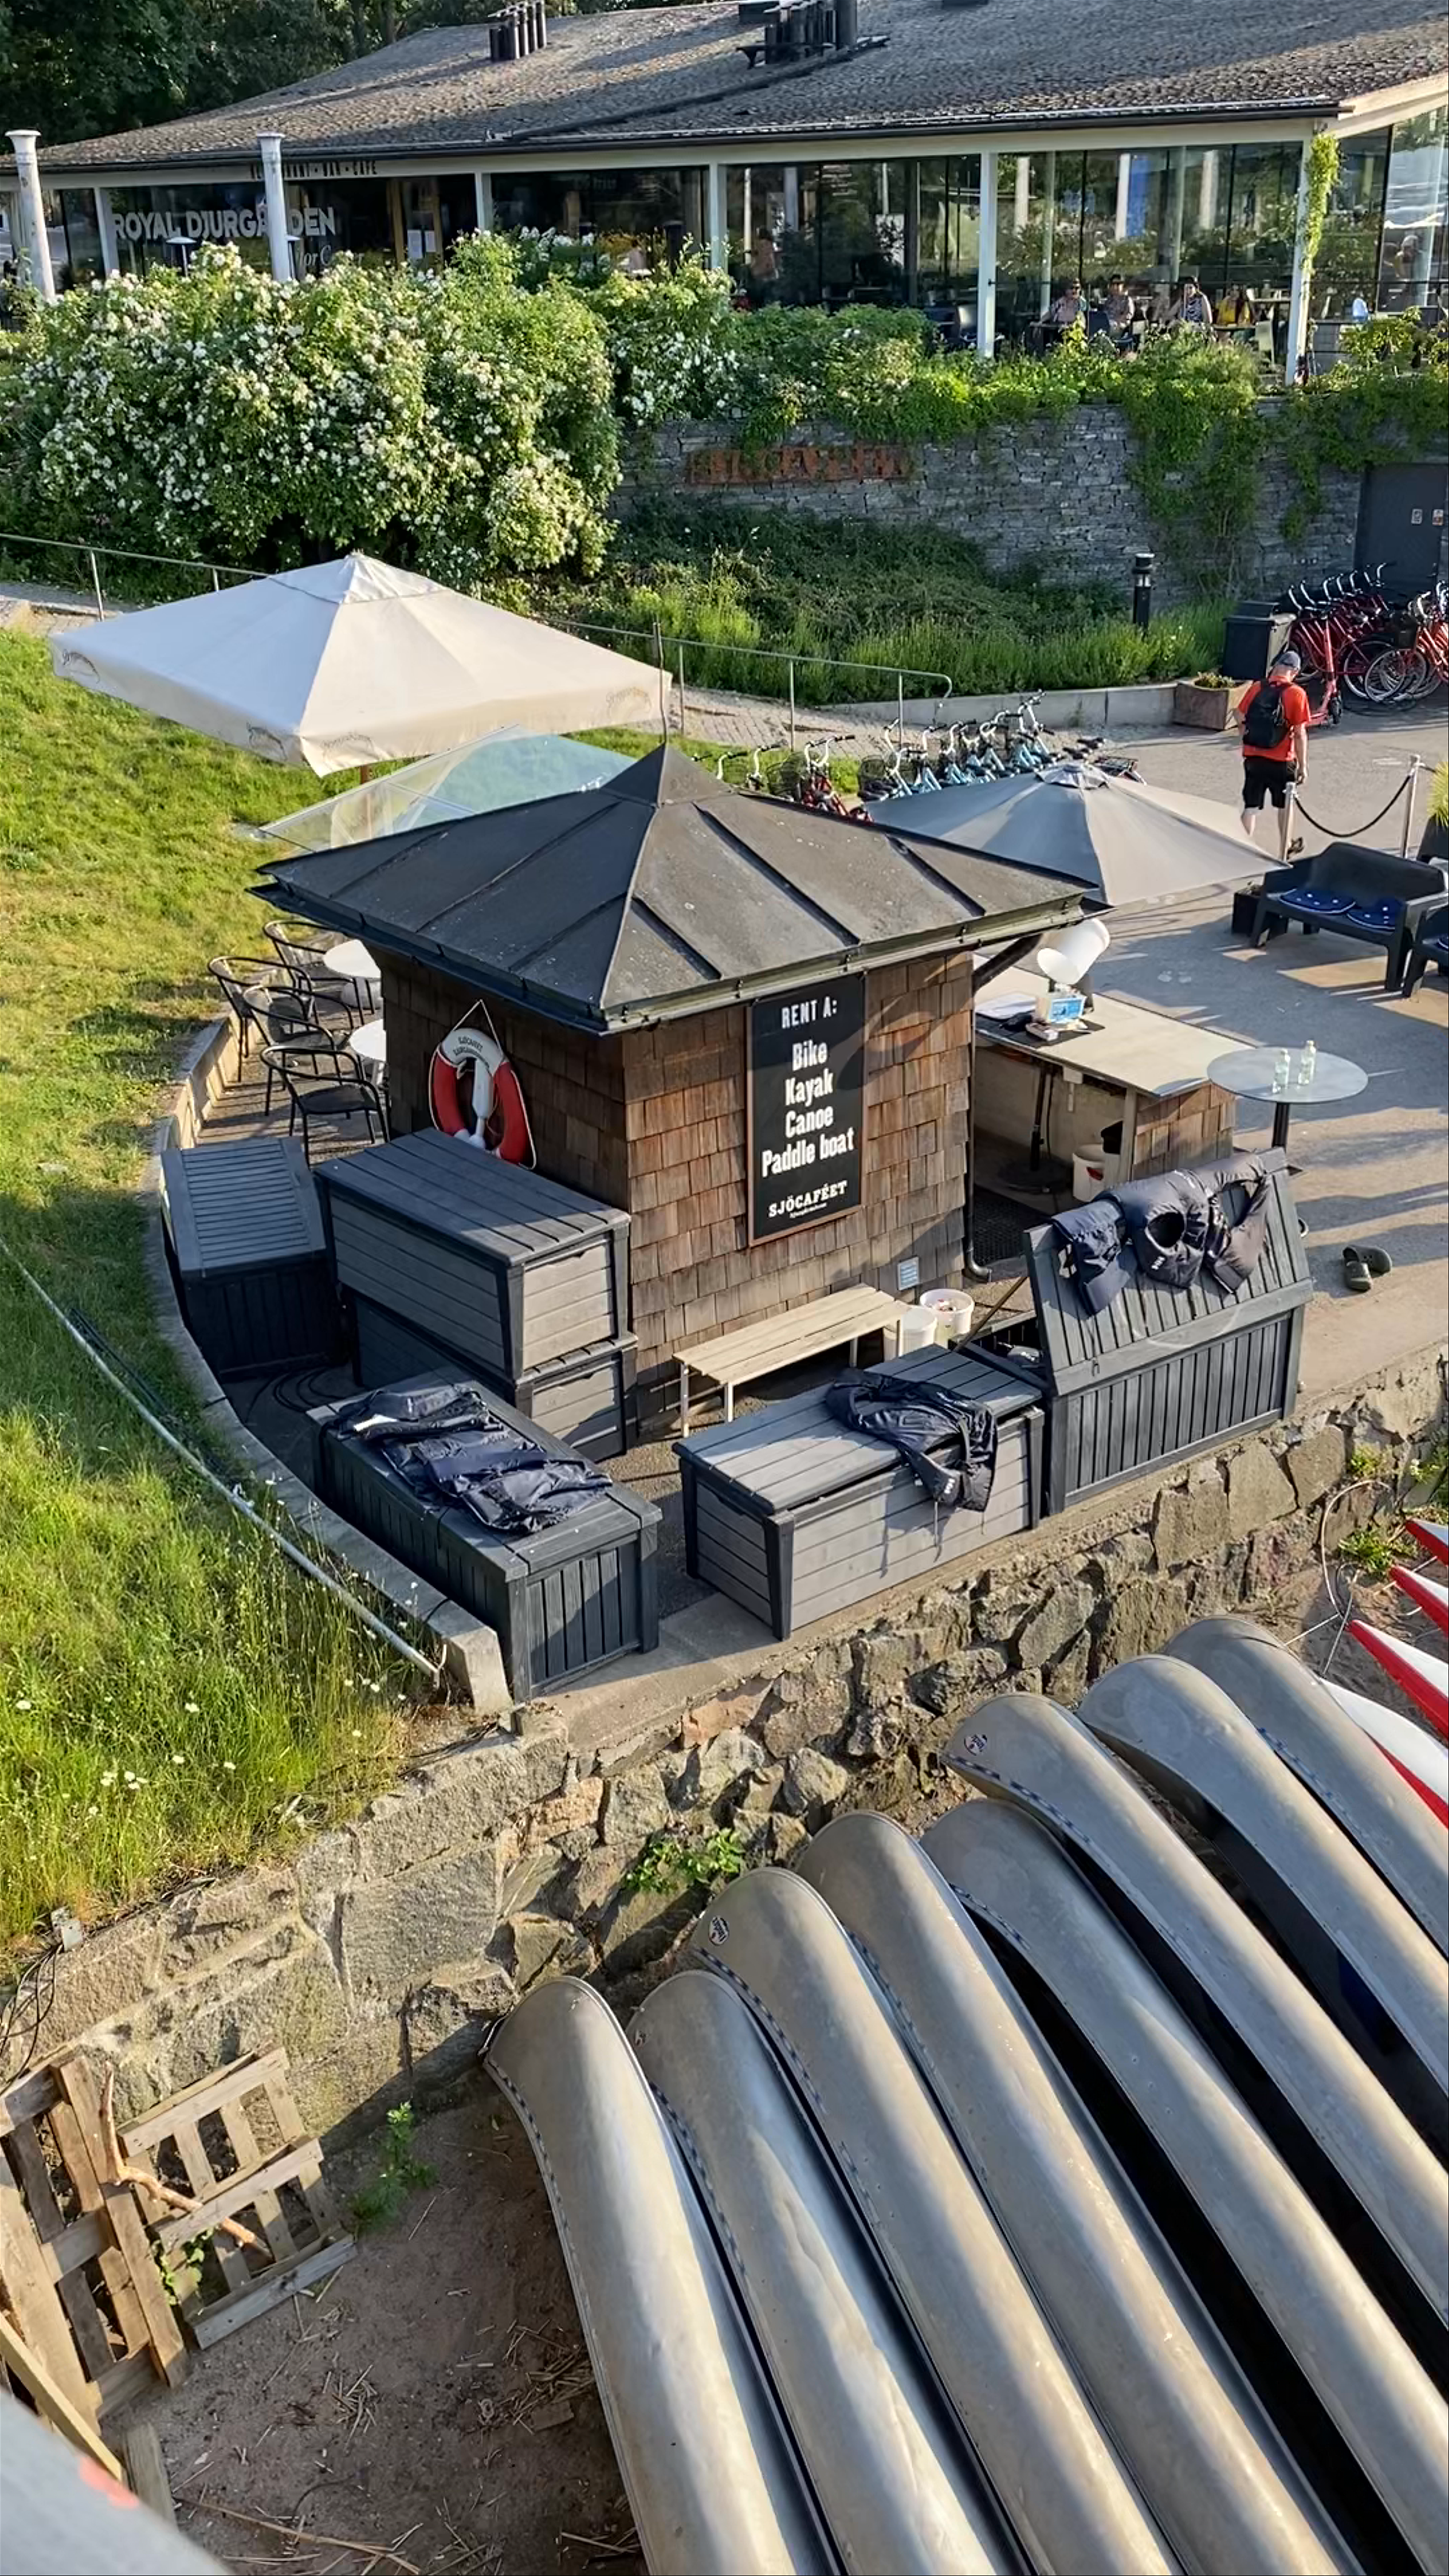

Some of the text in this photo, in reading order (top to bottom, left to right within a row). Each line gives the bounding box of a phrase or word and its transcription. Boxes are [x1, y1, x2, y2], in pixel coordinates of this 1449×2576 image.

[112, 211, 181, 240] ROYAL
[781, 997, 837, 1029] RENT A:
[792, 1039, 828, 1071] Bike
[785, 1067, 834, 1107] Kayak
[785, 1106, 834, 1138] Canoe
[761, 1126, 855, 1178] Paddle boat
[768, 1180, 848, 1218] SJÖCAFÉET
